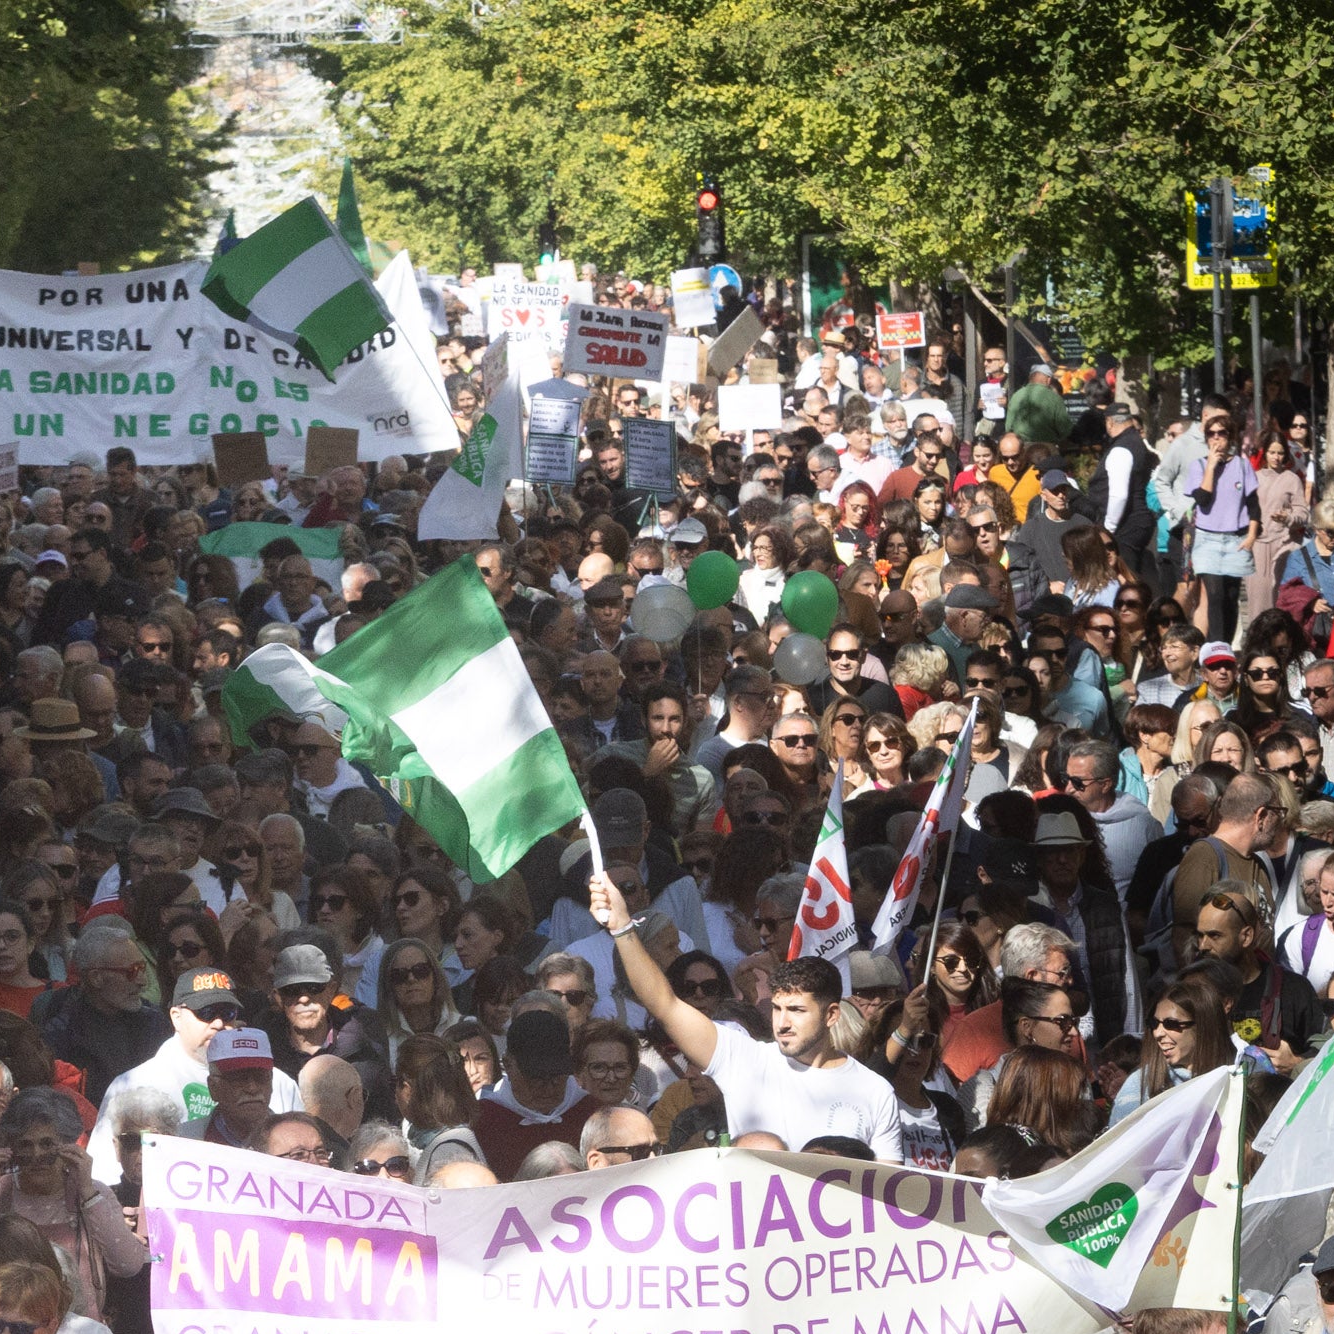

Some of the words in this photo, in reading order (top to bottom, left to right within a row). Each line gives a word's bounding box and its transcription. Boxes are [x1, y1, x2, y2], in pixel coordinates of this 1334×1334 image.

[39, 287, 105, 307] POR
[126, 279, 190, 303] UNA
[493, 283, 506, 293] LA
[514, 284, 559, 297] SANIDAD
[176, 327, 193, 349] Y
[224, 328, 258, 354] DE
[585, 342, 648, 367] SALUD
[29, 370, 176, 396] SANIDAD
[210, 366, 259, 403] NO
[273, 377, 310, 402] ES
[13, 413, 65, 437] UN
[192, 972, 231, 991] AC/DC
[166, 1161, 411, 1226] GRANADA
[1058, 1197, 1124, 1229] SANIDAD
[1067, 1212, 1127, 1244] PÚBLICA
[1082, 1232, 1121, 1255] 100%
[168, 1221, 427, 1306] AMAMA
[483, 1273, 521, 1302] DE
[534, 1263, 751, 1311] MUJERES
[764, 1230, 1016, 1302] OPERADAS
